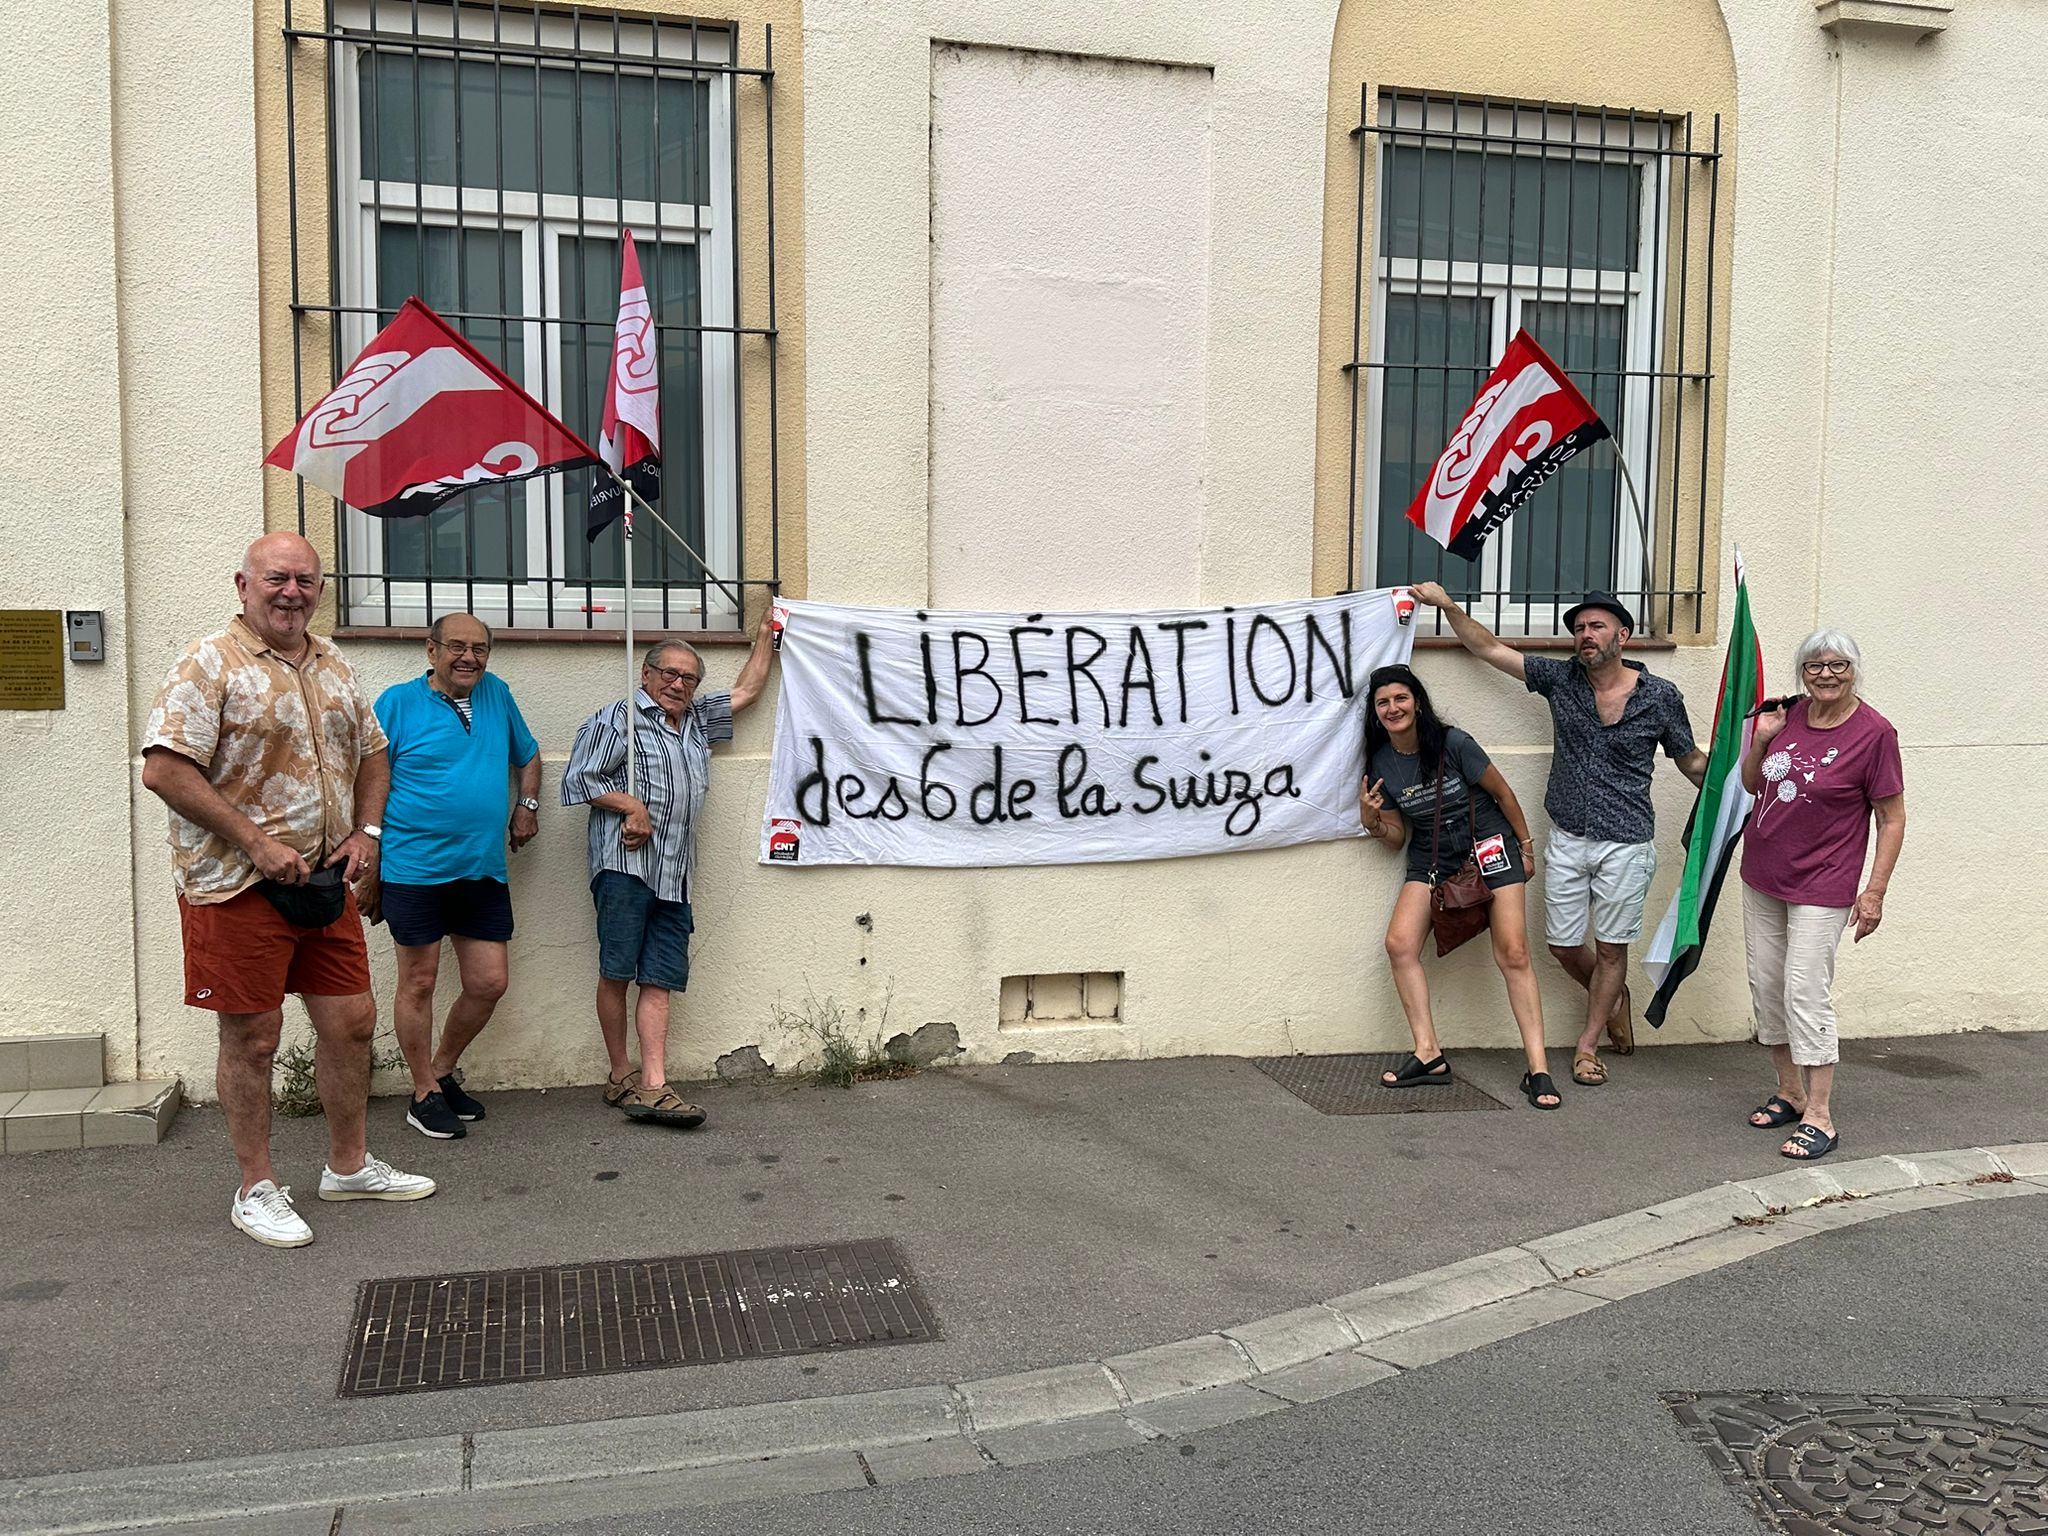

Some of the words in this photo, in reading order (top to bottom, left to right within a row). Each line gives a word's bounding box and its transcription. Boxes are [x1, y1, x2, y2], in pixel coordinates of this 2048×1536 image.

[798, 737, 908, 828] des
[918, 741, 957, 823] 6
[968, 744, 1037, 826] de
[1056, 743, 1122, 819] la
[1131, 751, 1301, 837] Suiza
[774, 842, 795, 851] CNT
[1483, 854, 1502, 864] CNT
